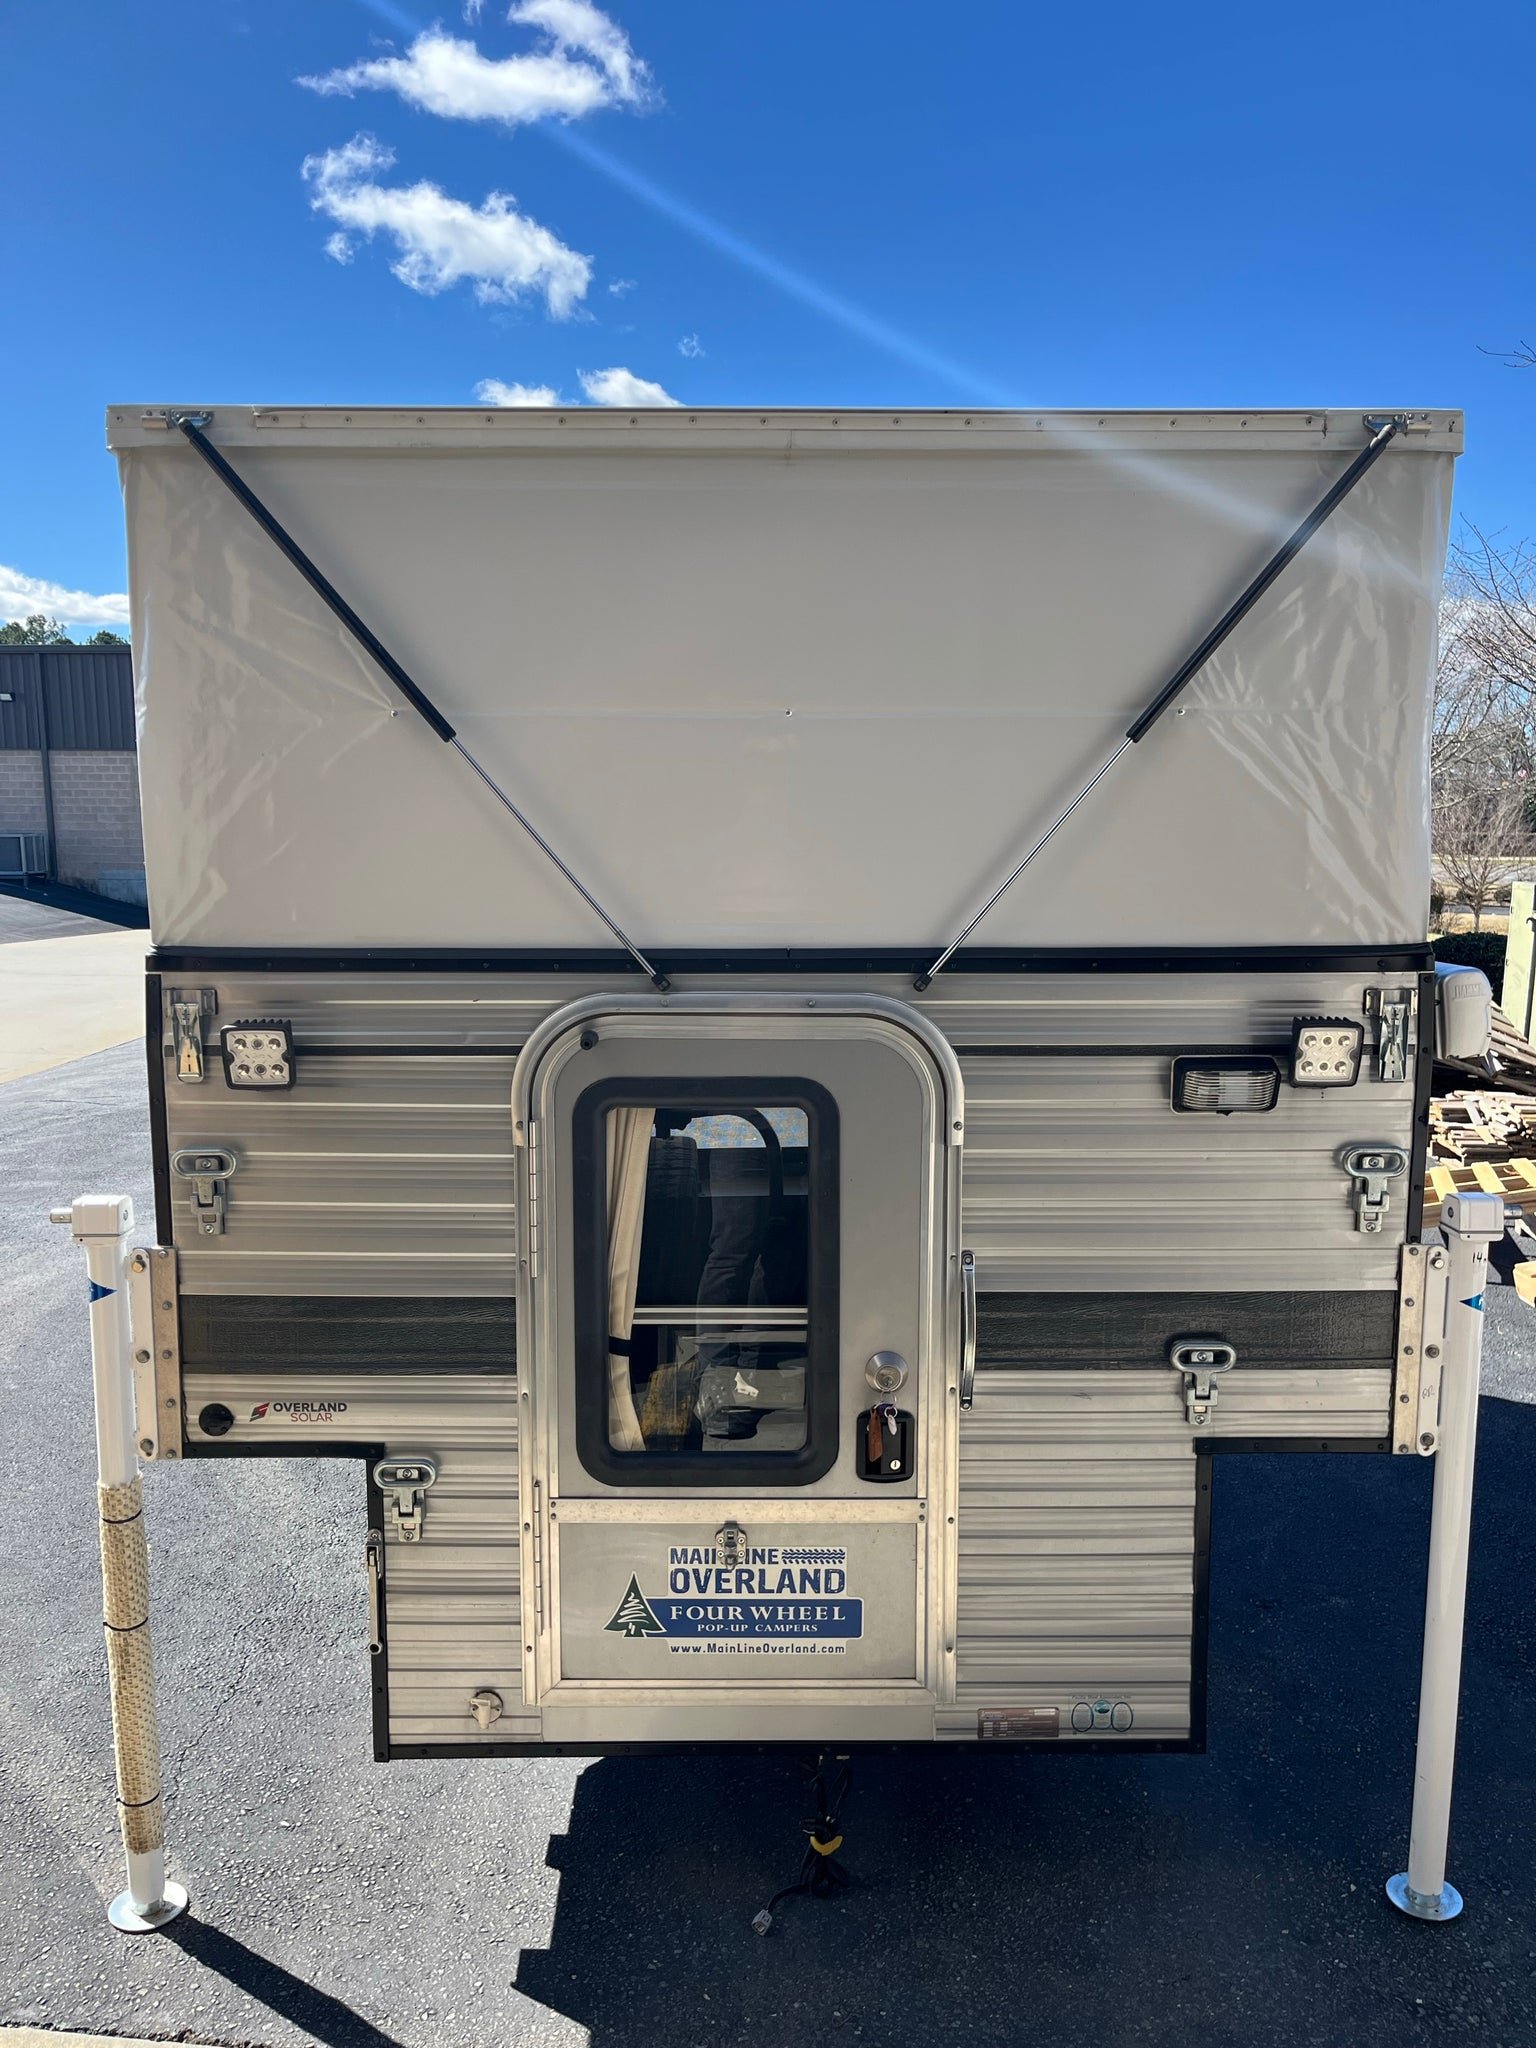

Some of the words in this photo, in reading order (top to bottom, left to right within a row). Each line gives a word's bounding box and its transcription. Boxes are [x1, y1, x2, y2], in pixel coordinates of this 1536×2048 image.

[273, 1402, 348, 1413] OVERLAND
[290, 1412, 333, 1423] SOLAR
[737, 1548, 779, 1565] INE
[670, 1568, 846, 1594] OVERLAND
[670, 1605, 744, 1621] FOUR
[749, 1605, 846, 1621] WHEEL
[697, 1624, 748, 1632] POP-UP
[755, 1624, 818, 1632] CAMPERS
[670, 1643, 845, 1654] www.MainLineOverland.com
